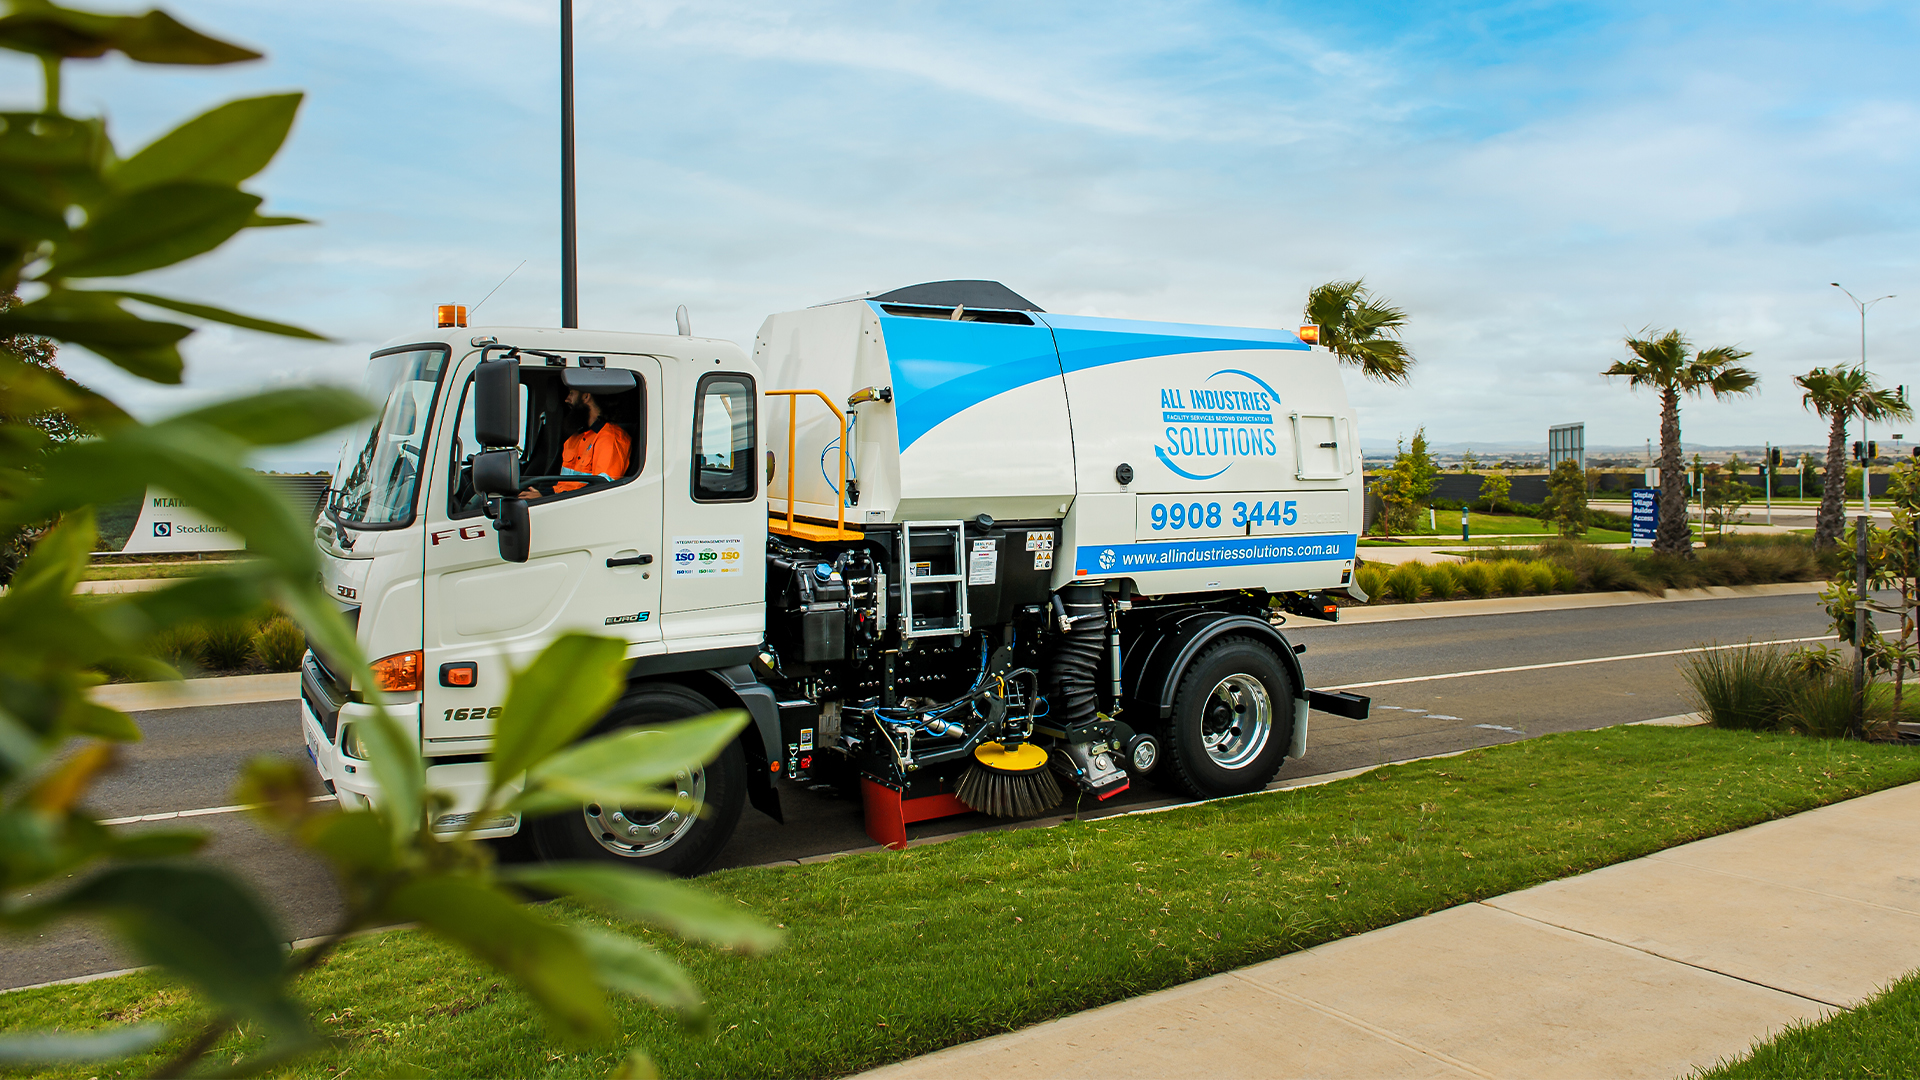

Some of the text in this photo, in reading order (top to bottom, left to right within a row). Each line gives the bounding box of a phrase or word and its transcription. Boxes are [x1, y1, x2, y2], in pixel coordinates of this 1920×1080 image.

[1161, 388, 1271, 411] ALL INDUSTRIES
[1165, 427, 1276, 456] SOLUTIONS
[1634, 492, 1654, 500] Display
[1633, 500, 1653, 508] Village
[1151, 501, 1298, 531] 9908 3445
[1301, 512, 1342, 525] BUCHER
[176, 524, 228, 534] Stockland
[430, 524, 486, 546] FG
[675, 553, 695, 562] ISO
[698, 552, 718, 561] ISO
[721, 551, 740, 560] ISO
[1122, 543, 1340, 566] www.allindustriessolutions.com.au
[443, 706, 503, 721] 1628
